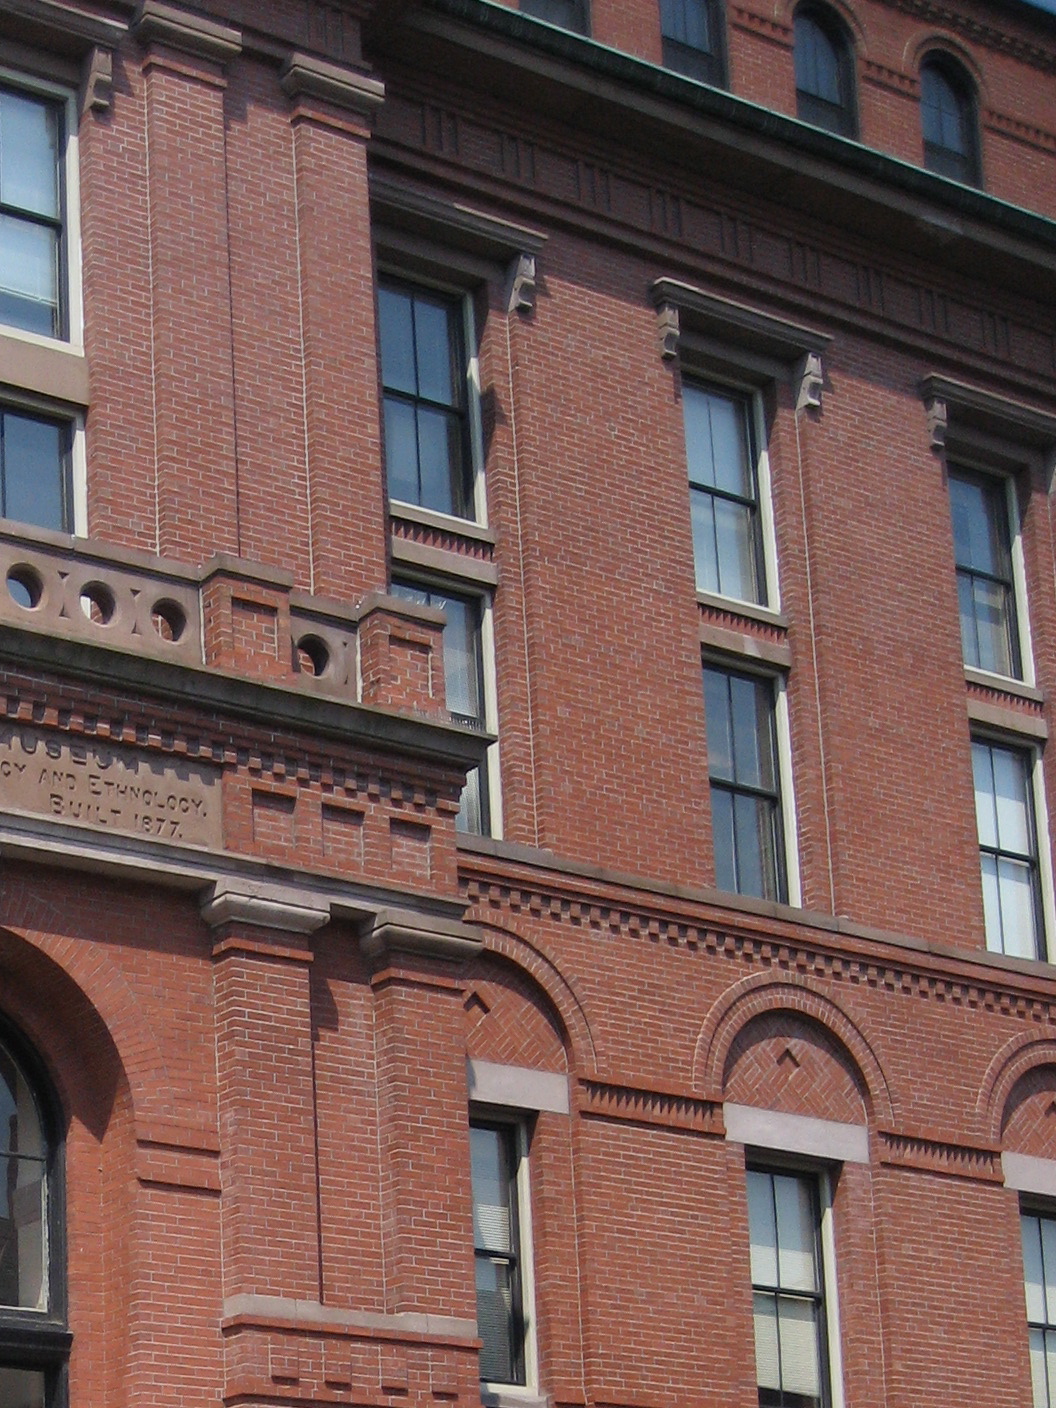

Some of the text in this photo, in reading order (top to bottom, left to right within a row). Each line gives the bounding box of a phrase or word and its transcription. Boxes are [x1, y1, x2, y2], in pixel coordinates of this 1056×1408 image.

[37, 768, 77, 791] AND
[87, 774, 208, 818] ETHNOLOGY.
[49, 793, 183, 839] BUILT 1877.
